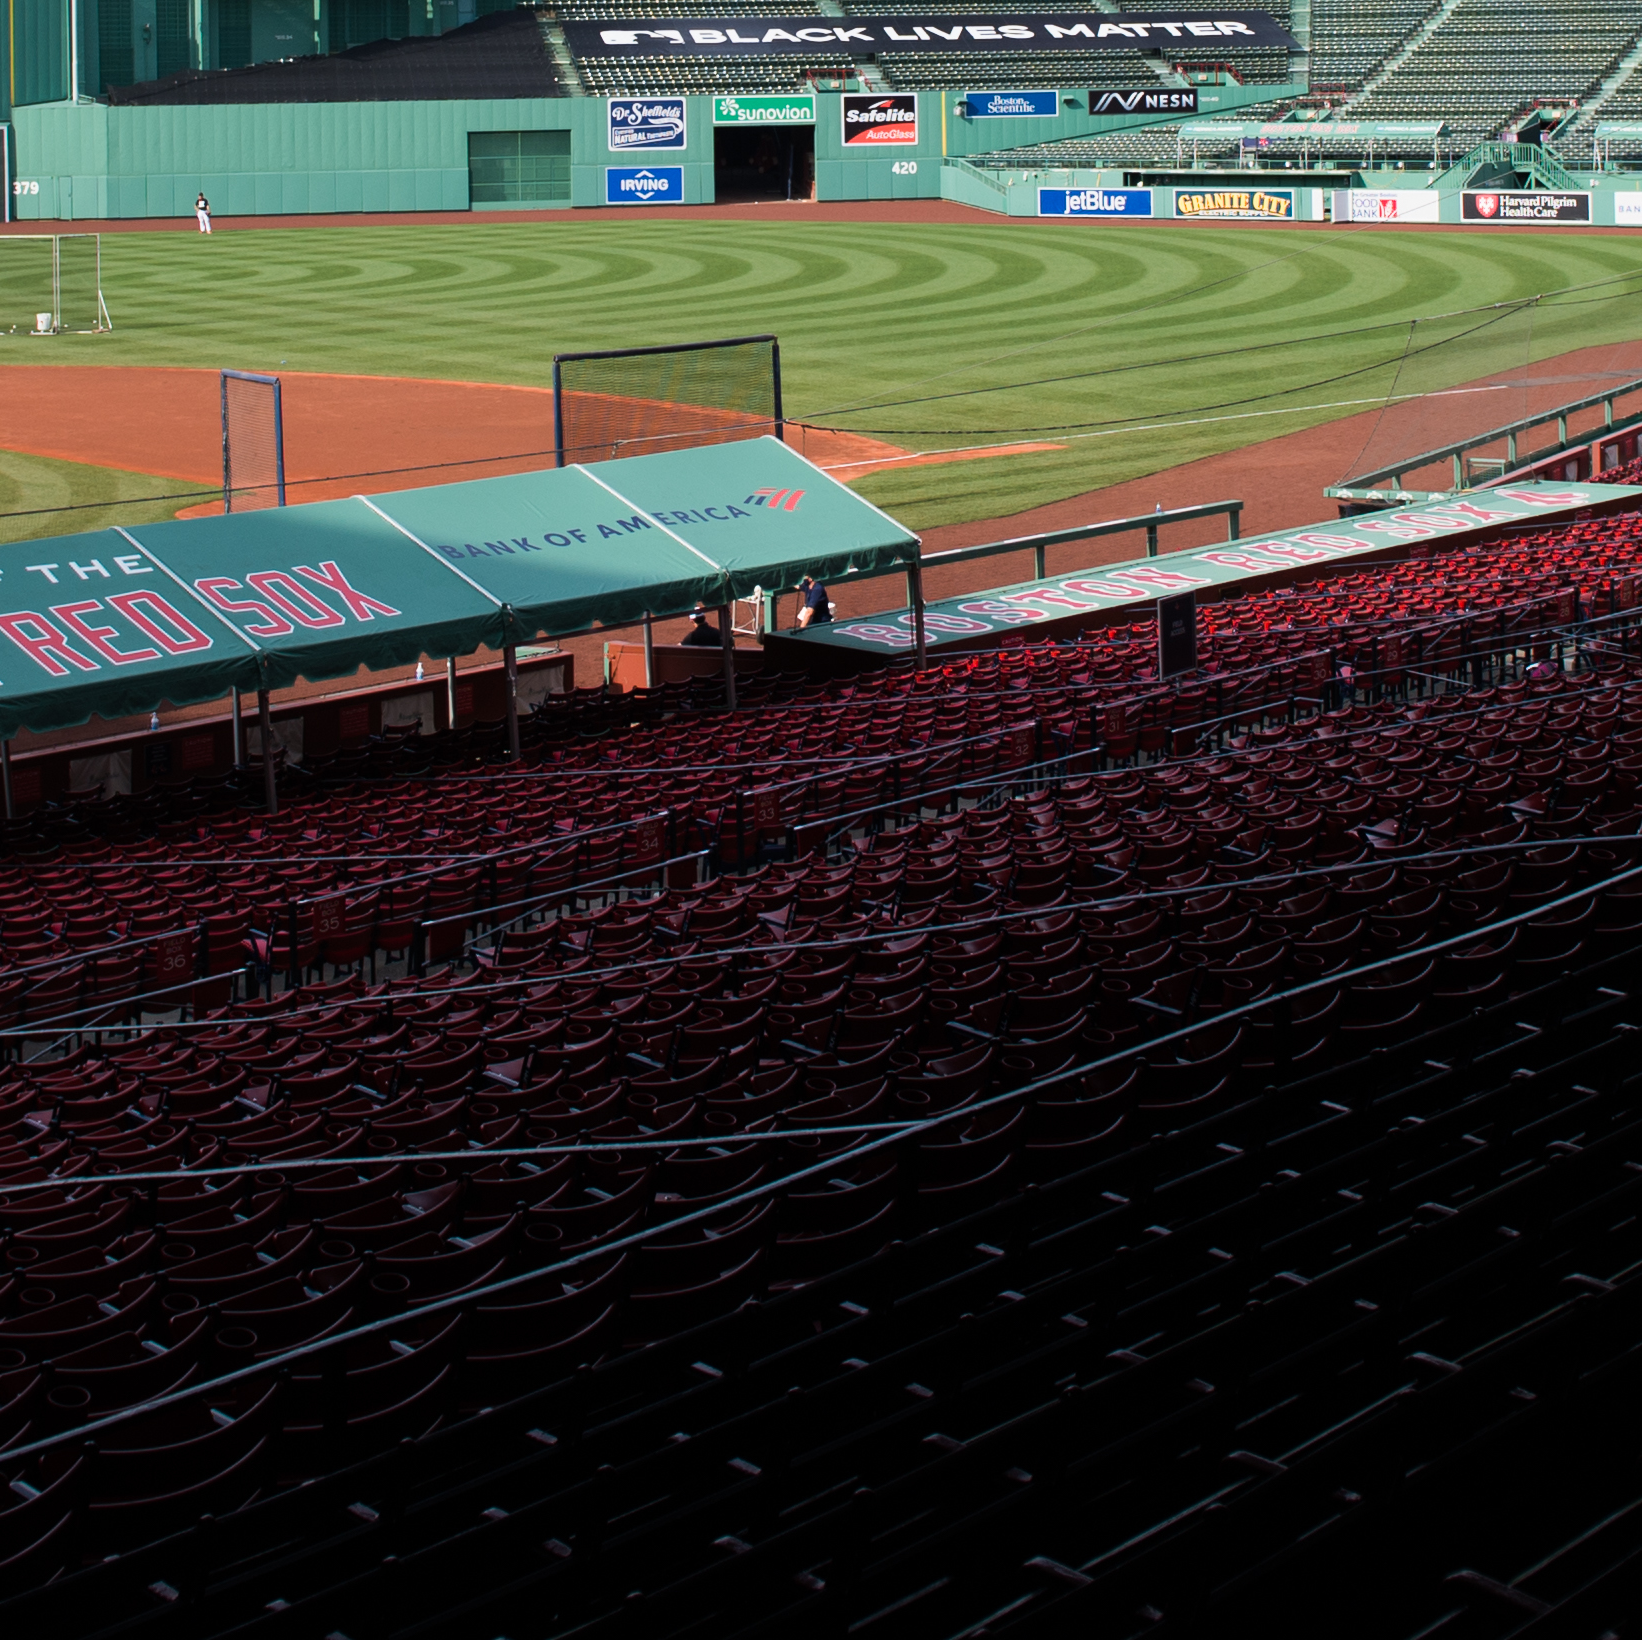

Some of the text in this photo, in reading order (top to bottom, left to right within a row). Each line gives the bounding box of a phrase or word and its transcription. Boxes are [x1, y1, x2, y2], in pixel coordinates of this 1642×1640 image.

[690, 20, 1255, 45] BLACK LIVES MATTER
[987, 102, 1036, 114] Scientific
[994, 95, 1024, 106] Boston
[1145, 93, 1195, 110] NESN
[737, 105, 811, 121] sunovion
[846, 108, 915, 122] Safelite
[866, 129, 914, 139] AutoGlass
[892, 161, 917, 174] 420
[12, 181, 39, 195] 379
[620, 178, 669, 191] IRVING
[1064, 189, 1124, 213] jetBlue
[1178, 192, 1290, 214] GRANITE CITY
[1500, 196, 1577, 209] Harvard Pilgrim
[440, 501, 747, 561] BANK OF AMERICA
[24, 553, 155, 588] THE
[833, 501, 1530, 647] BOSTON RED SOX
[194, 560, 403, 638] SOX
[1015, 744, 1030, 757] 32
[758, 808, 775, 821] 33
[640, 836, 660, 851] 34
[318, 917, 340, 932] 35
[162, 954, 186, 972] 36
